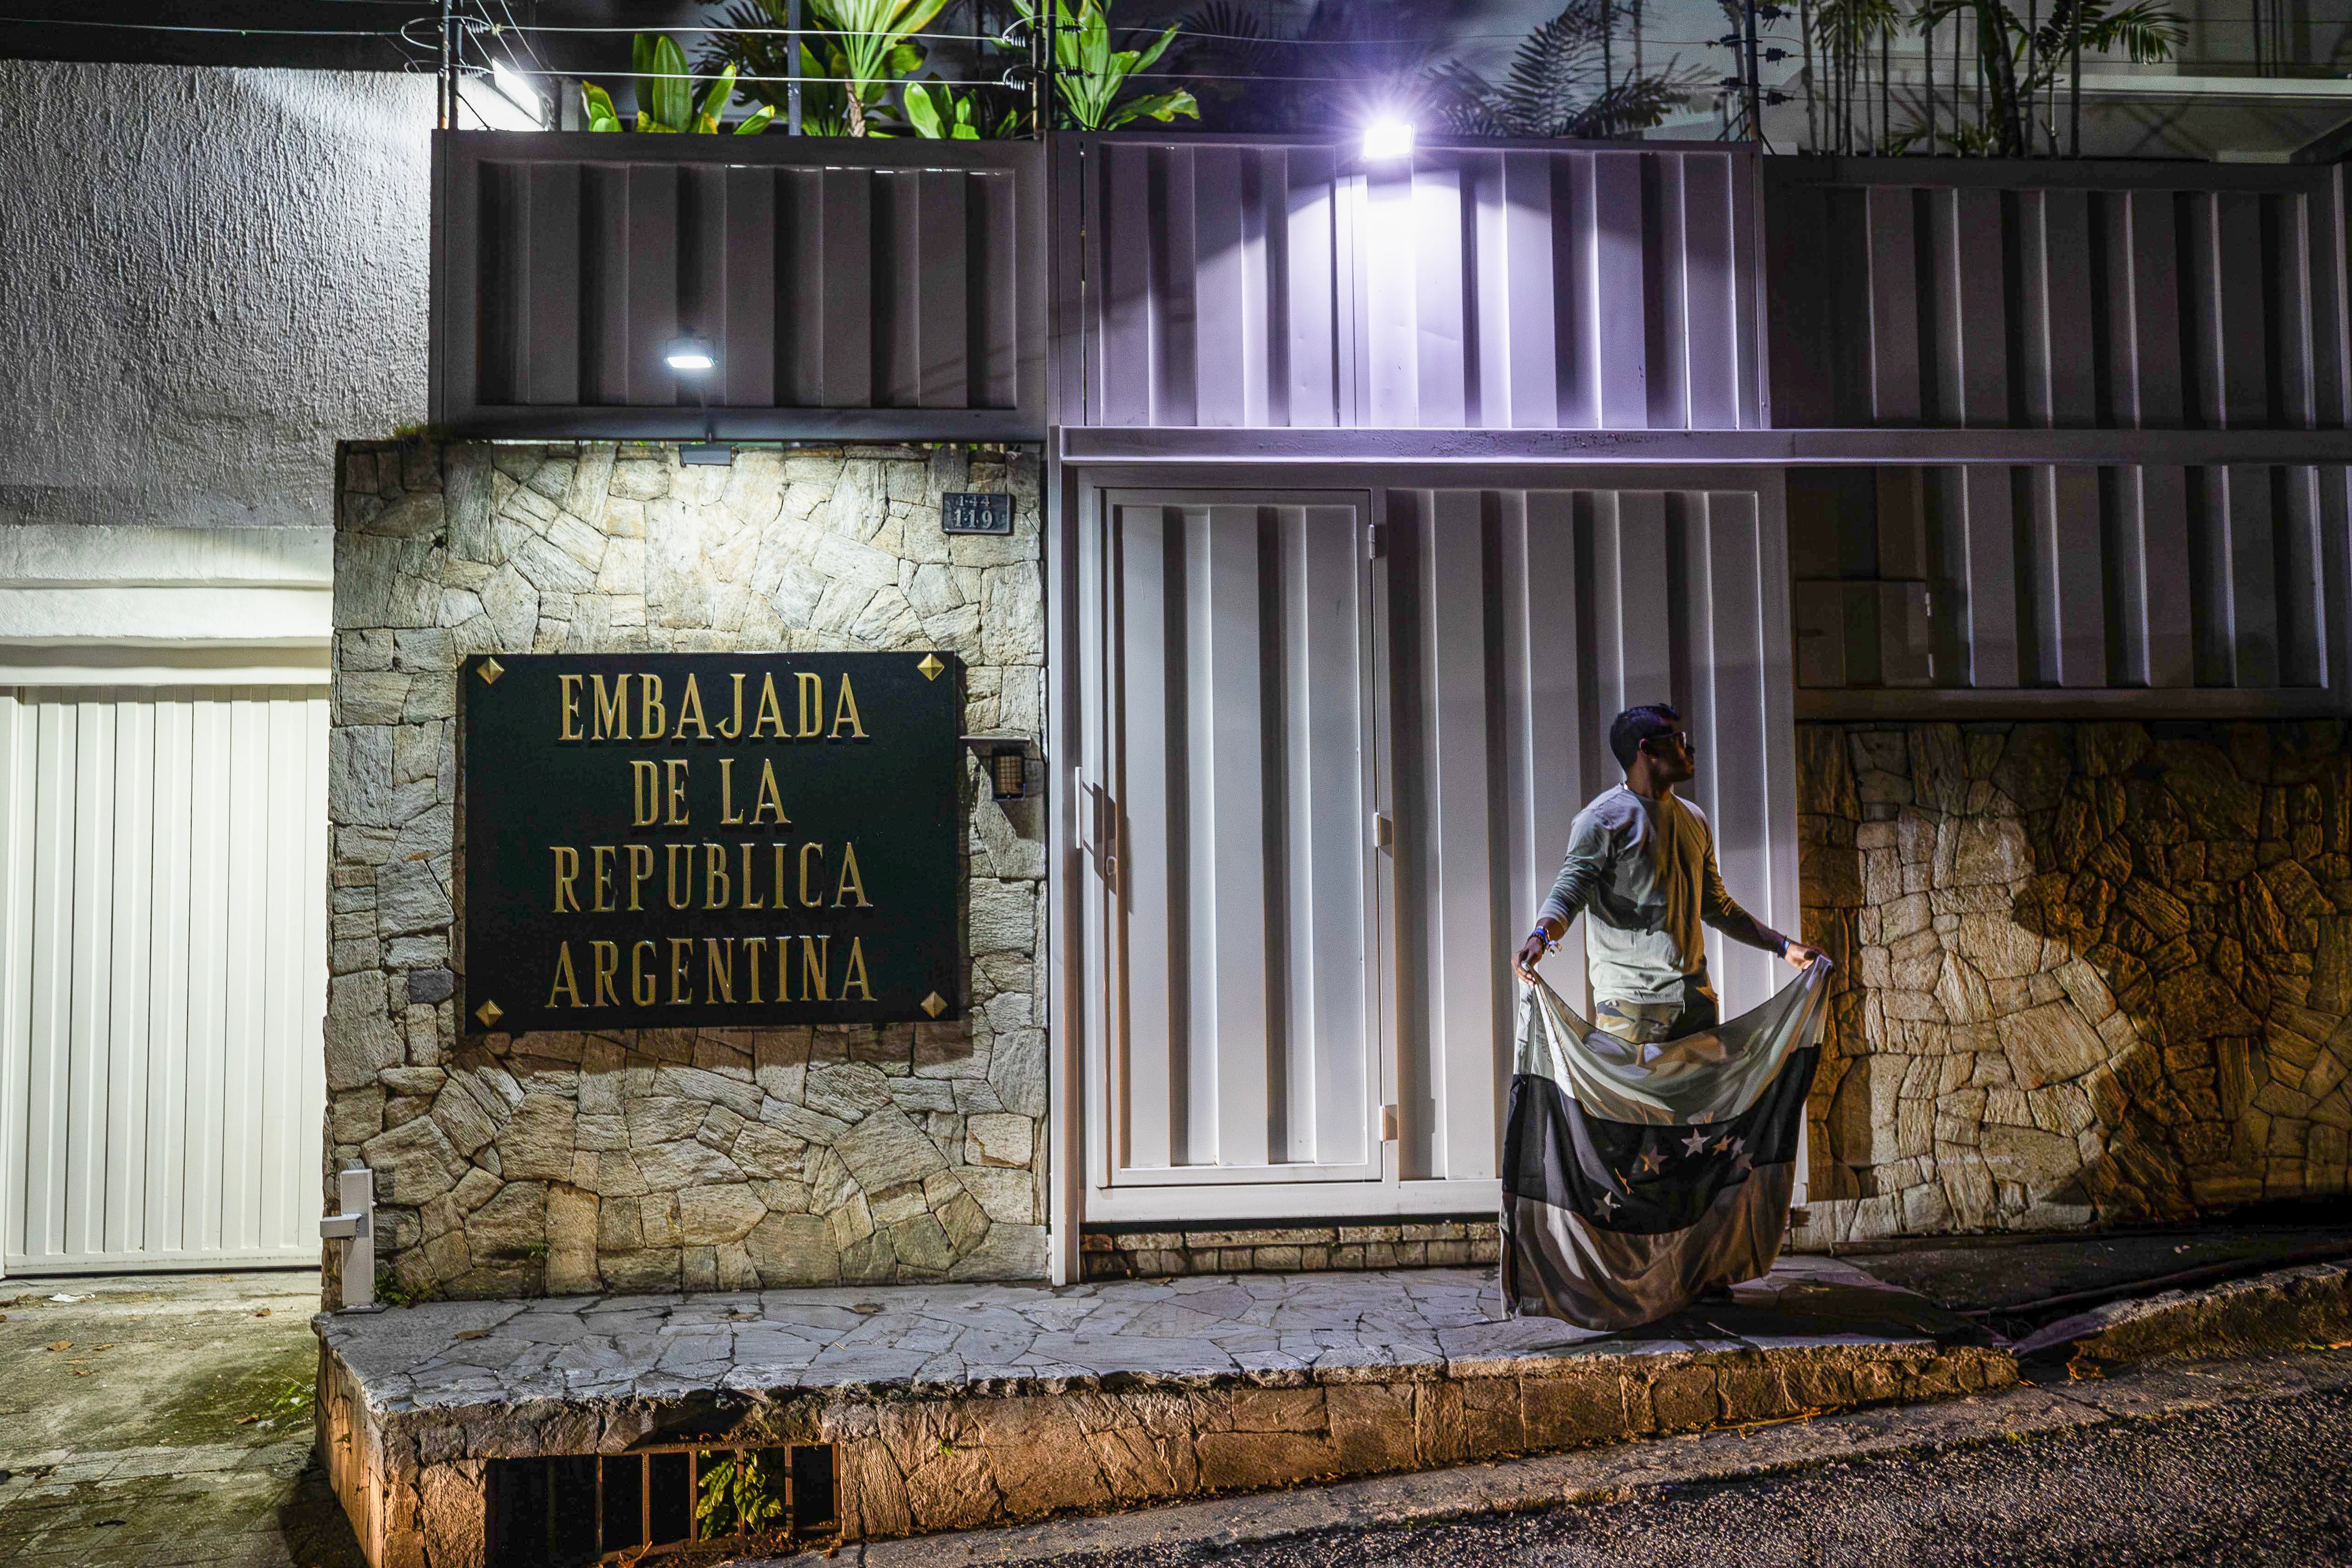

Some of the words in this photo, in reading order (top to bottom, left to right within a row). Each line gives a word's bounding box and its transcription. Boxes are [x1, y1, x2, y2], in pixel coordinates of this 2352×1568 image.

[557, 672, 870, 741] EMBAJADA
[629, 759, 690, 826] DE
[719, 758, 792, 825] LA
[549, 841, 874, 913] REPUBLICA
[544, 935, 877, 1008] ARGENTINA
